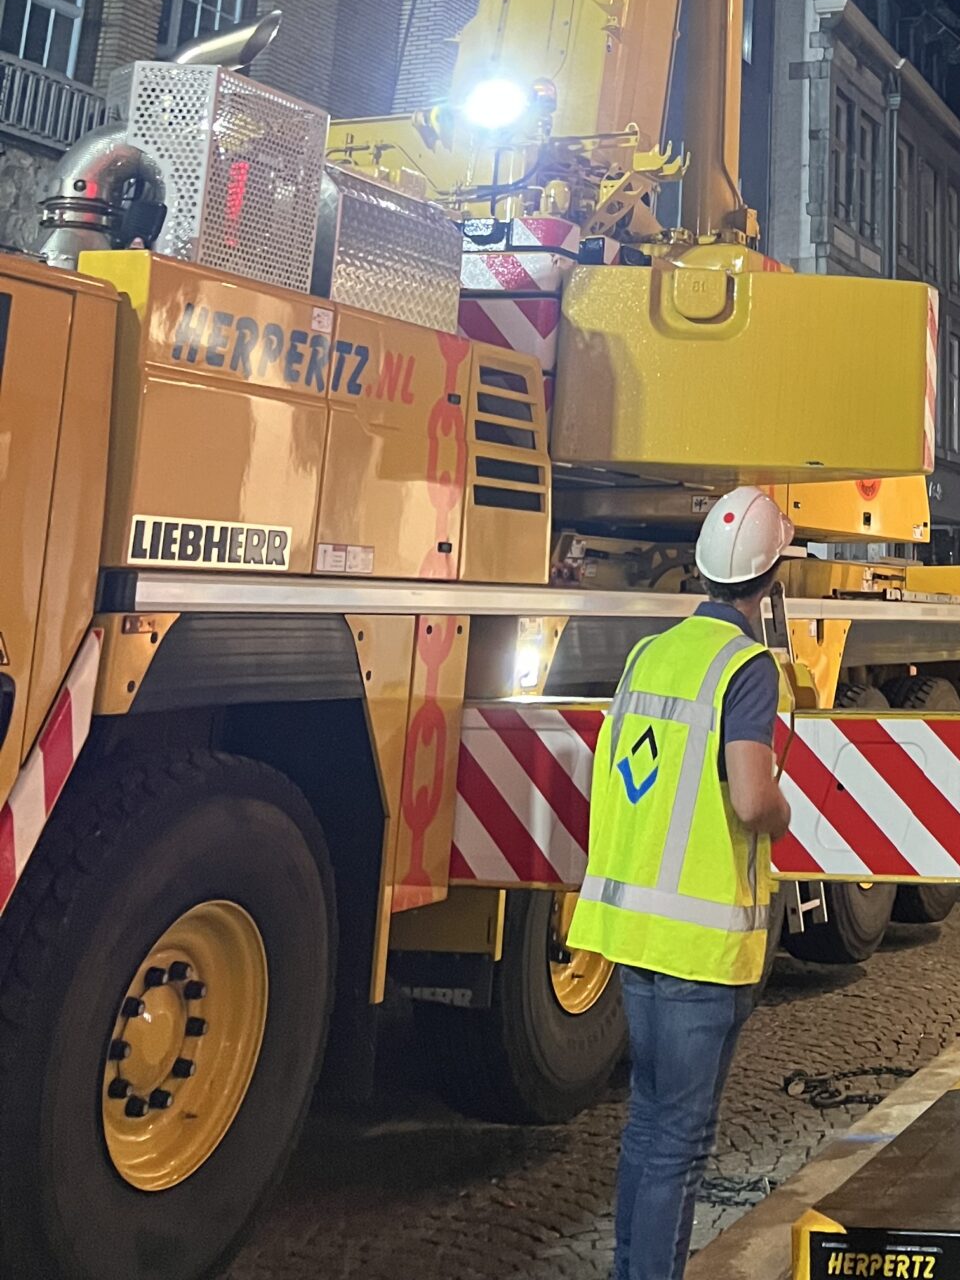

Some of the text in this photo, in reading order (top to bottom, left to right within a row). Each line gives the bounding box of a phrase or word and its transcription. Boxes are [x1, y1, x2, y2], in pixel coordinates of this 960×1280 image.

[171, 301, 416, 405] HERPERTZ.NL
[131, 519, 288, 566] LIEBHERR
[827, 1251, 936, 1279] HERPERTZ
